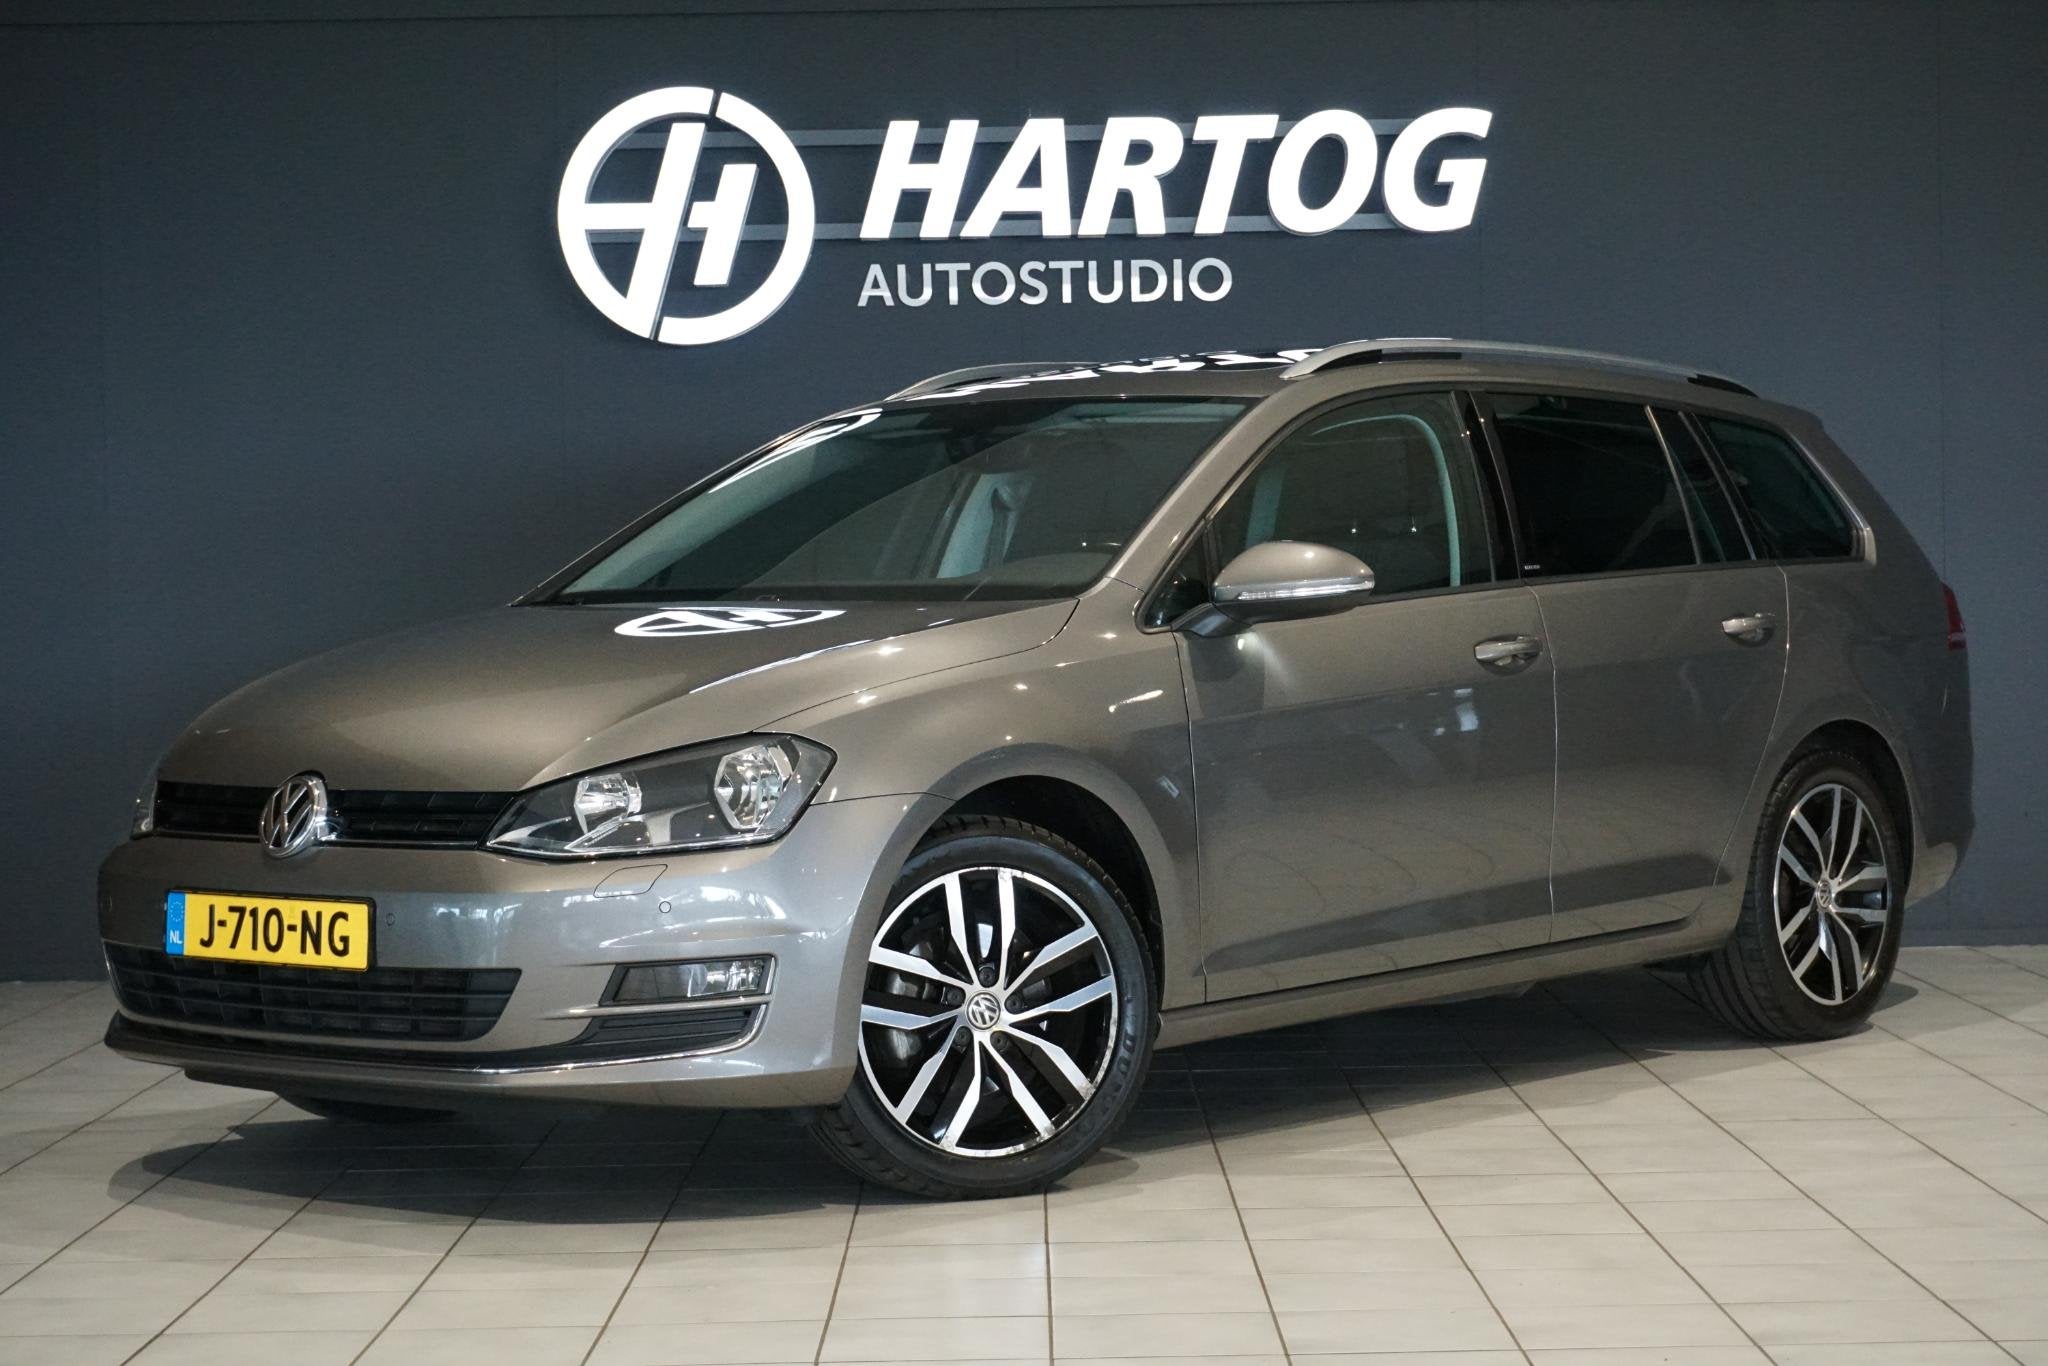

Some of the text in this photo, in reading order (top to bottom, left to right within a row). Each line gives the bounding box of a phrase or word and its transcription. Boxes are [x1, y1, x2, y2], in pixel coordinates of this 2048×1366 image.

[859, 107, 1493, 239] HARTOG
[857, 257, 1233, 307] AUTOSTUDIO
[169, 904, 350, 957] NL J-710-NG
